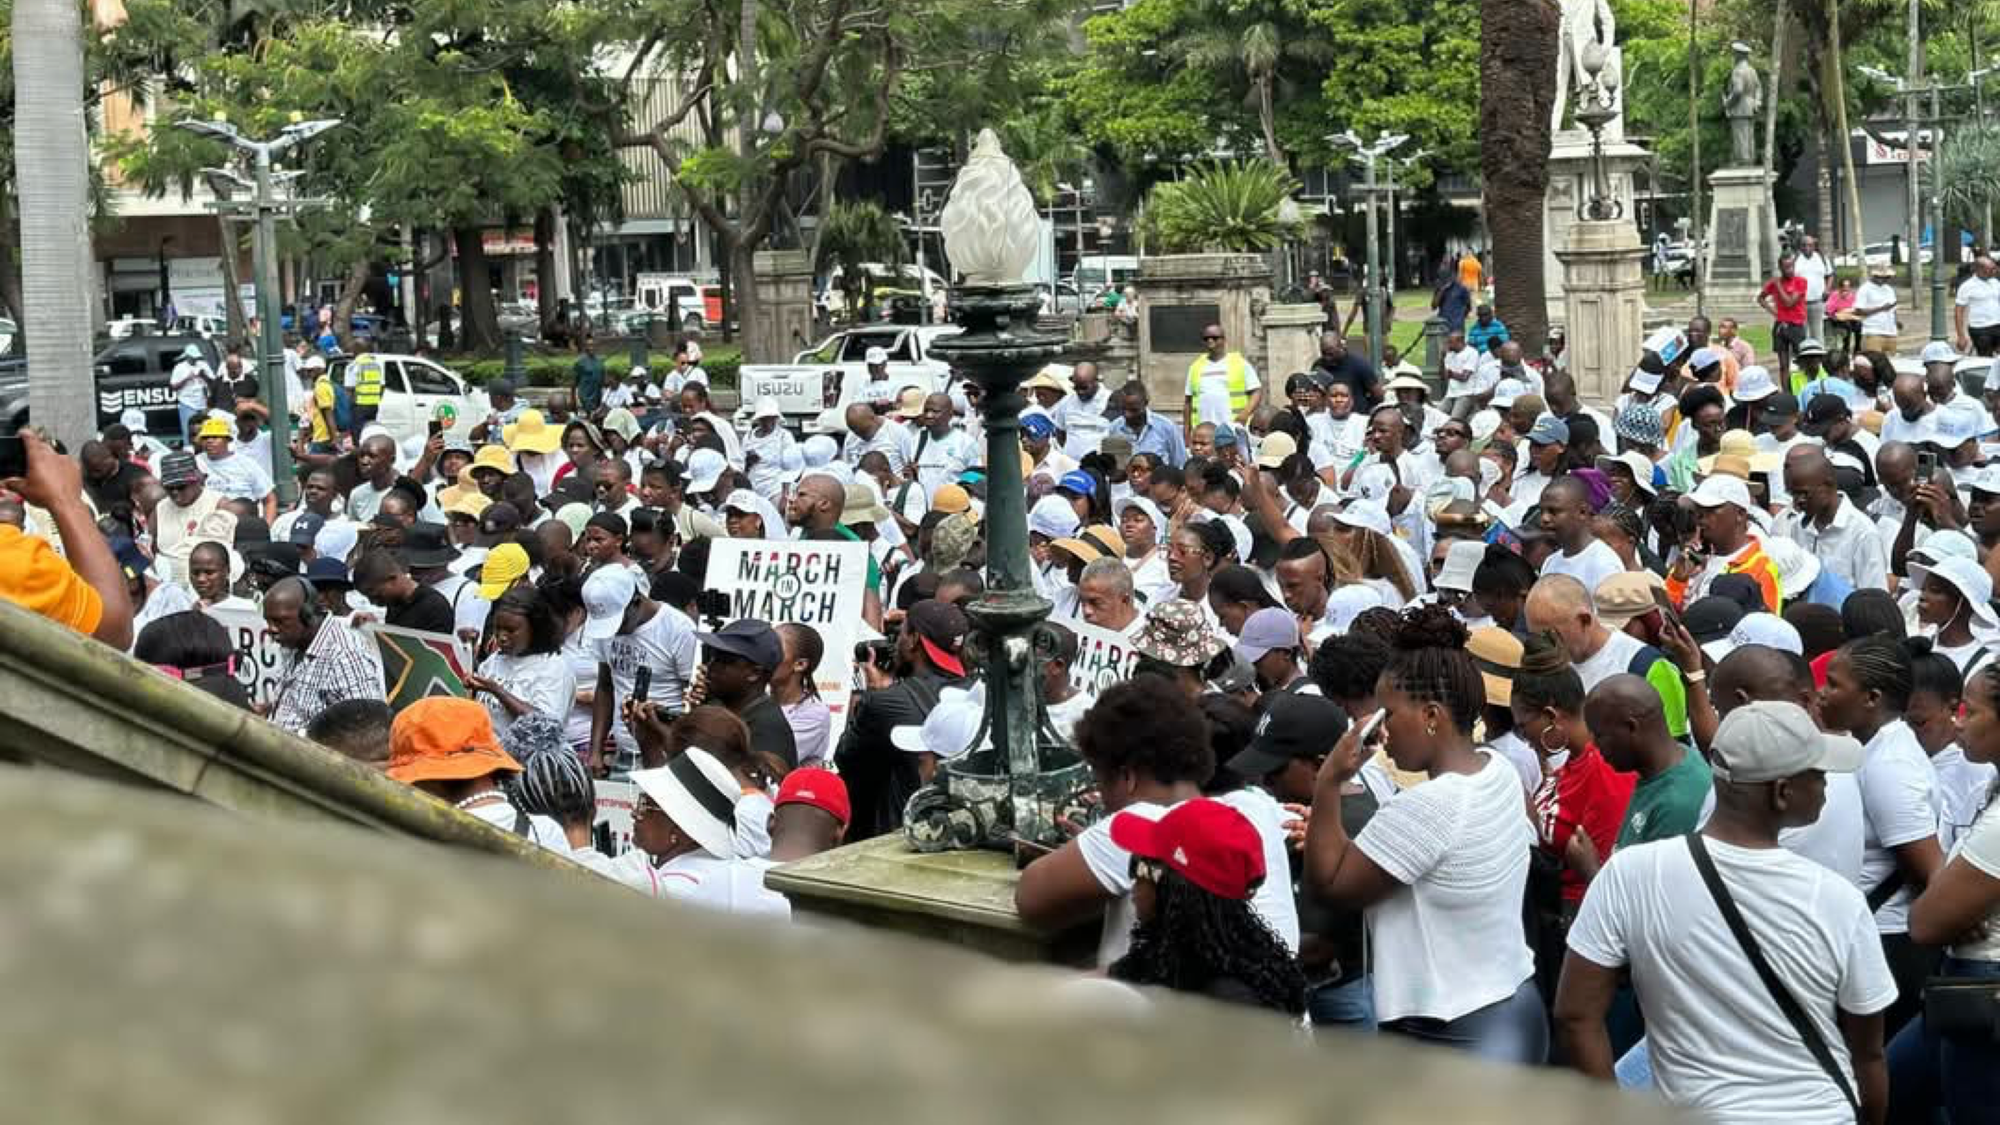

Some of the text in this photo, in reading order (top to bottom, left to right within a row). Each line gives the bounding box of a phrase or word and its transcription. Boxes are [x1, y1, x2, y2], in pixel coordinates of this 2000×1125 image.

[123, 387, 177, 405] ENSU
[756, 381, 804, 396] ISUZU
[738, 550, 841, 585] MARCH
[781, 580, 793, 590] IN
[733, 588, 836, 623] MARCH
[611, 640, 647, 662] MARCH
[1075, 635, 1141, 682] MARC
